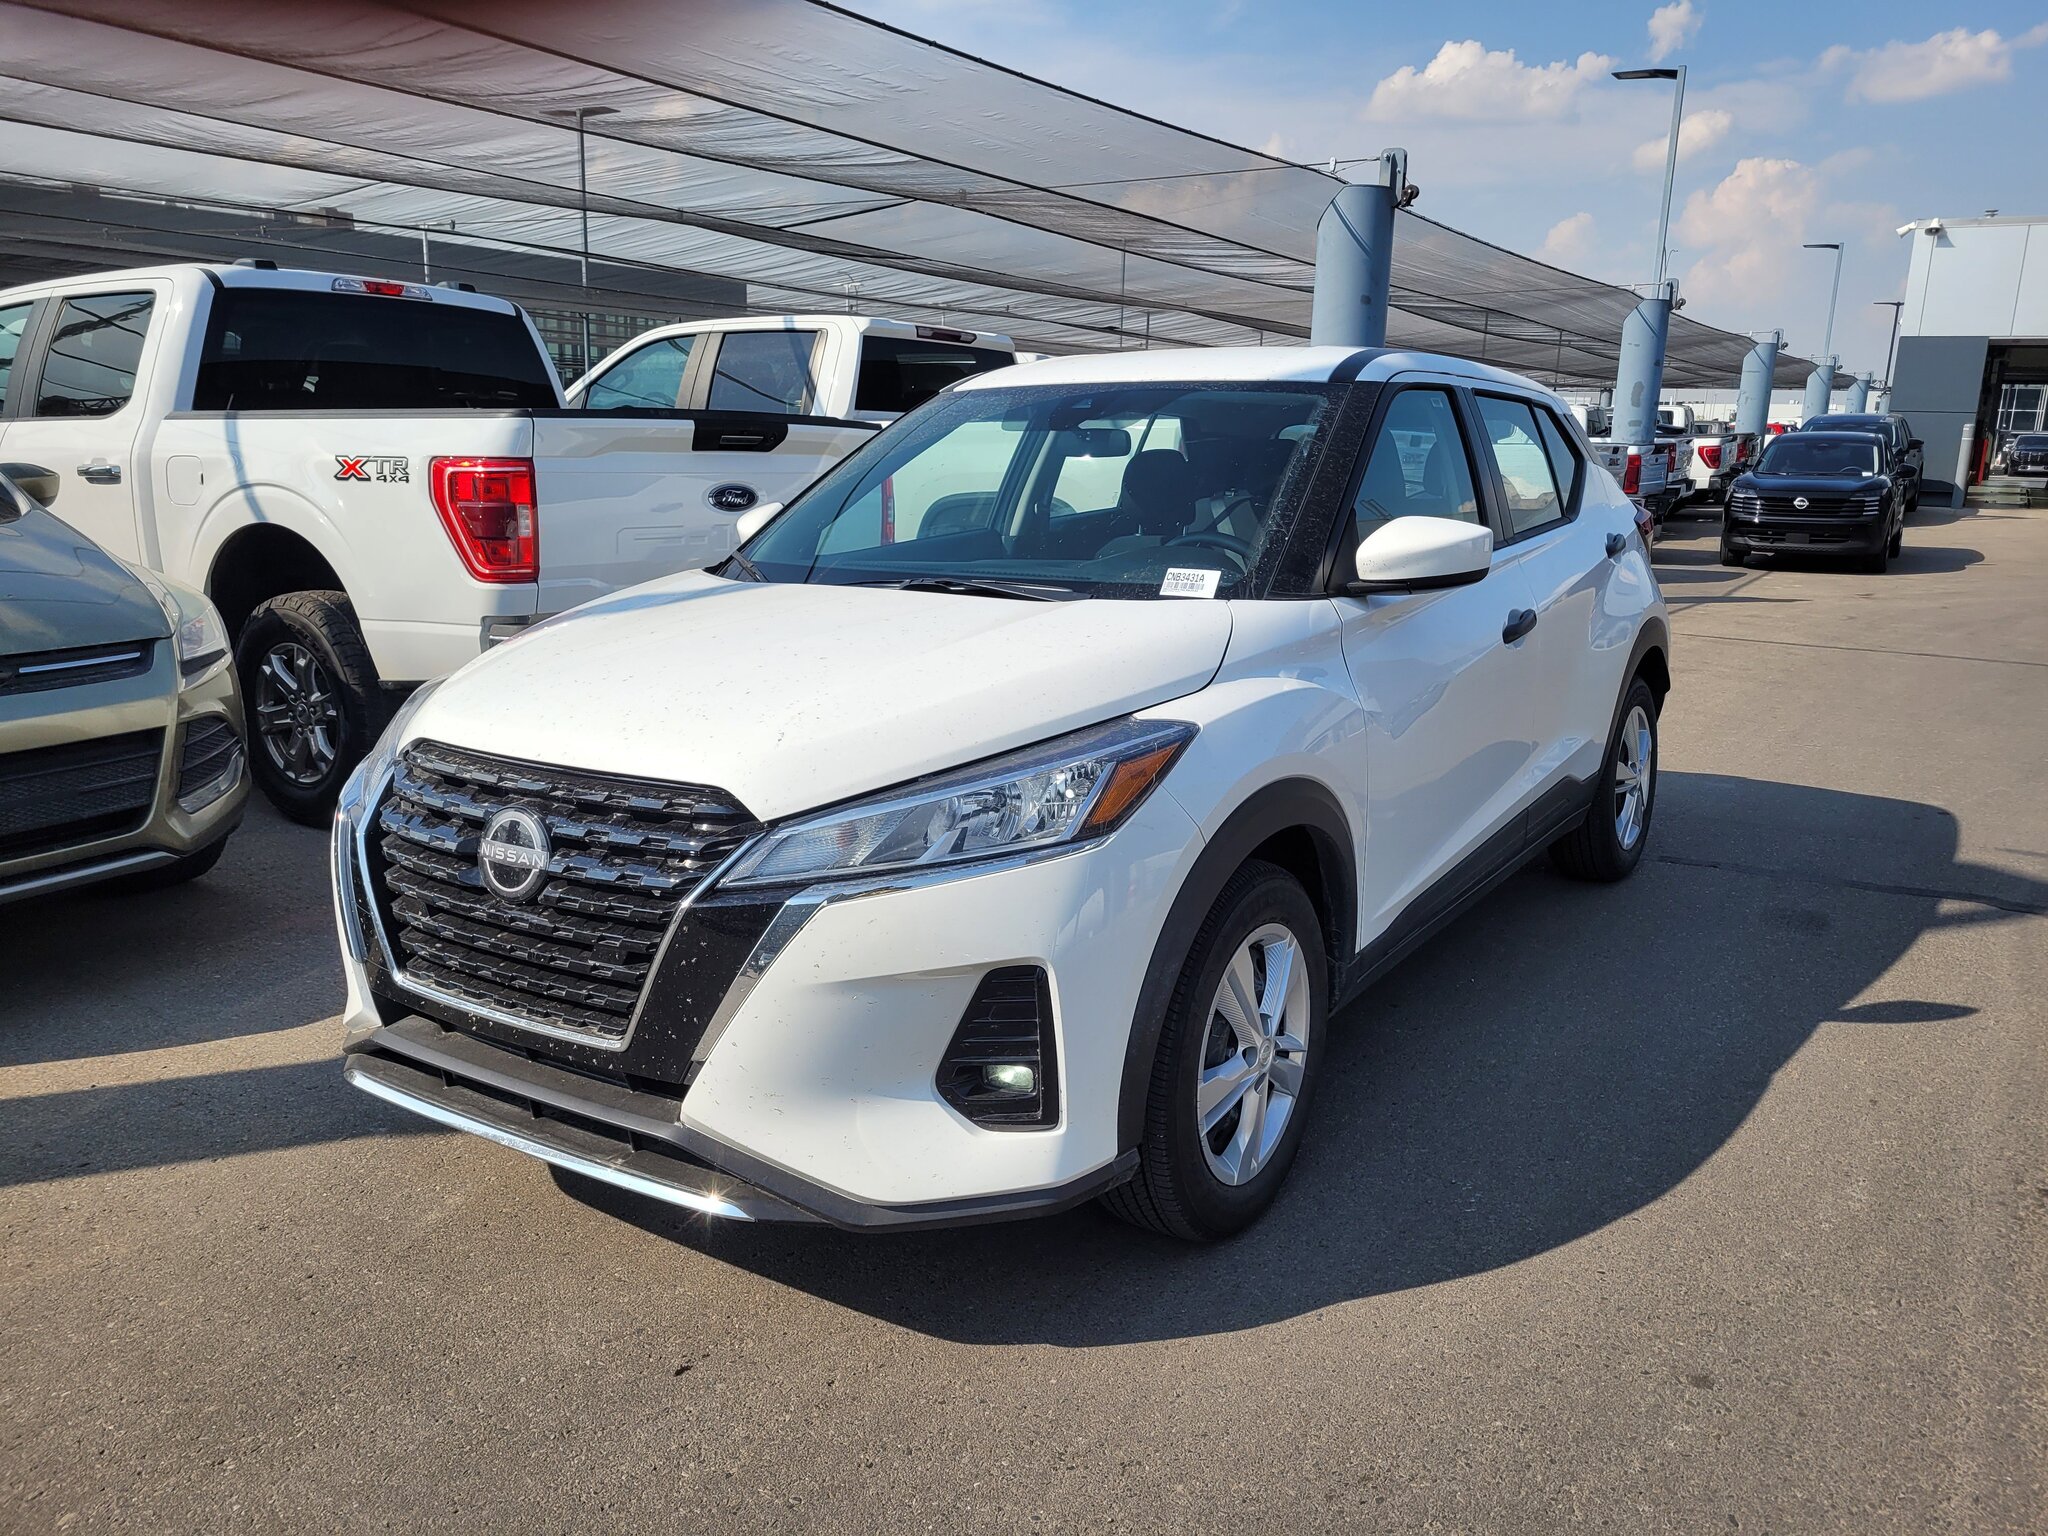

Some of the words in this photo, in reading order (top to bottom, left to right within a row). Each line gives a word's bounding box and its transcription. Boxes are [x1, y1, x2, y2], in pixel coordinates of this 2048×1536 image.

[334, 455, 410, 481] XTR
[722, 489, 749, 505] Ford
[1166, 572, 1205, 583] CNB3431A
[481, 842, 545, 867] NISSAN
